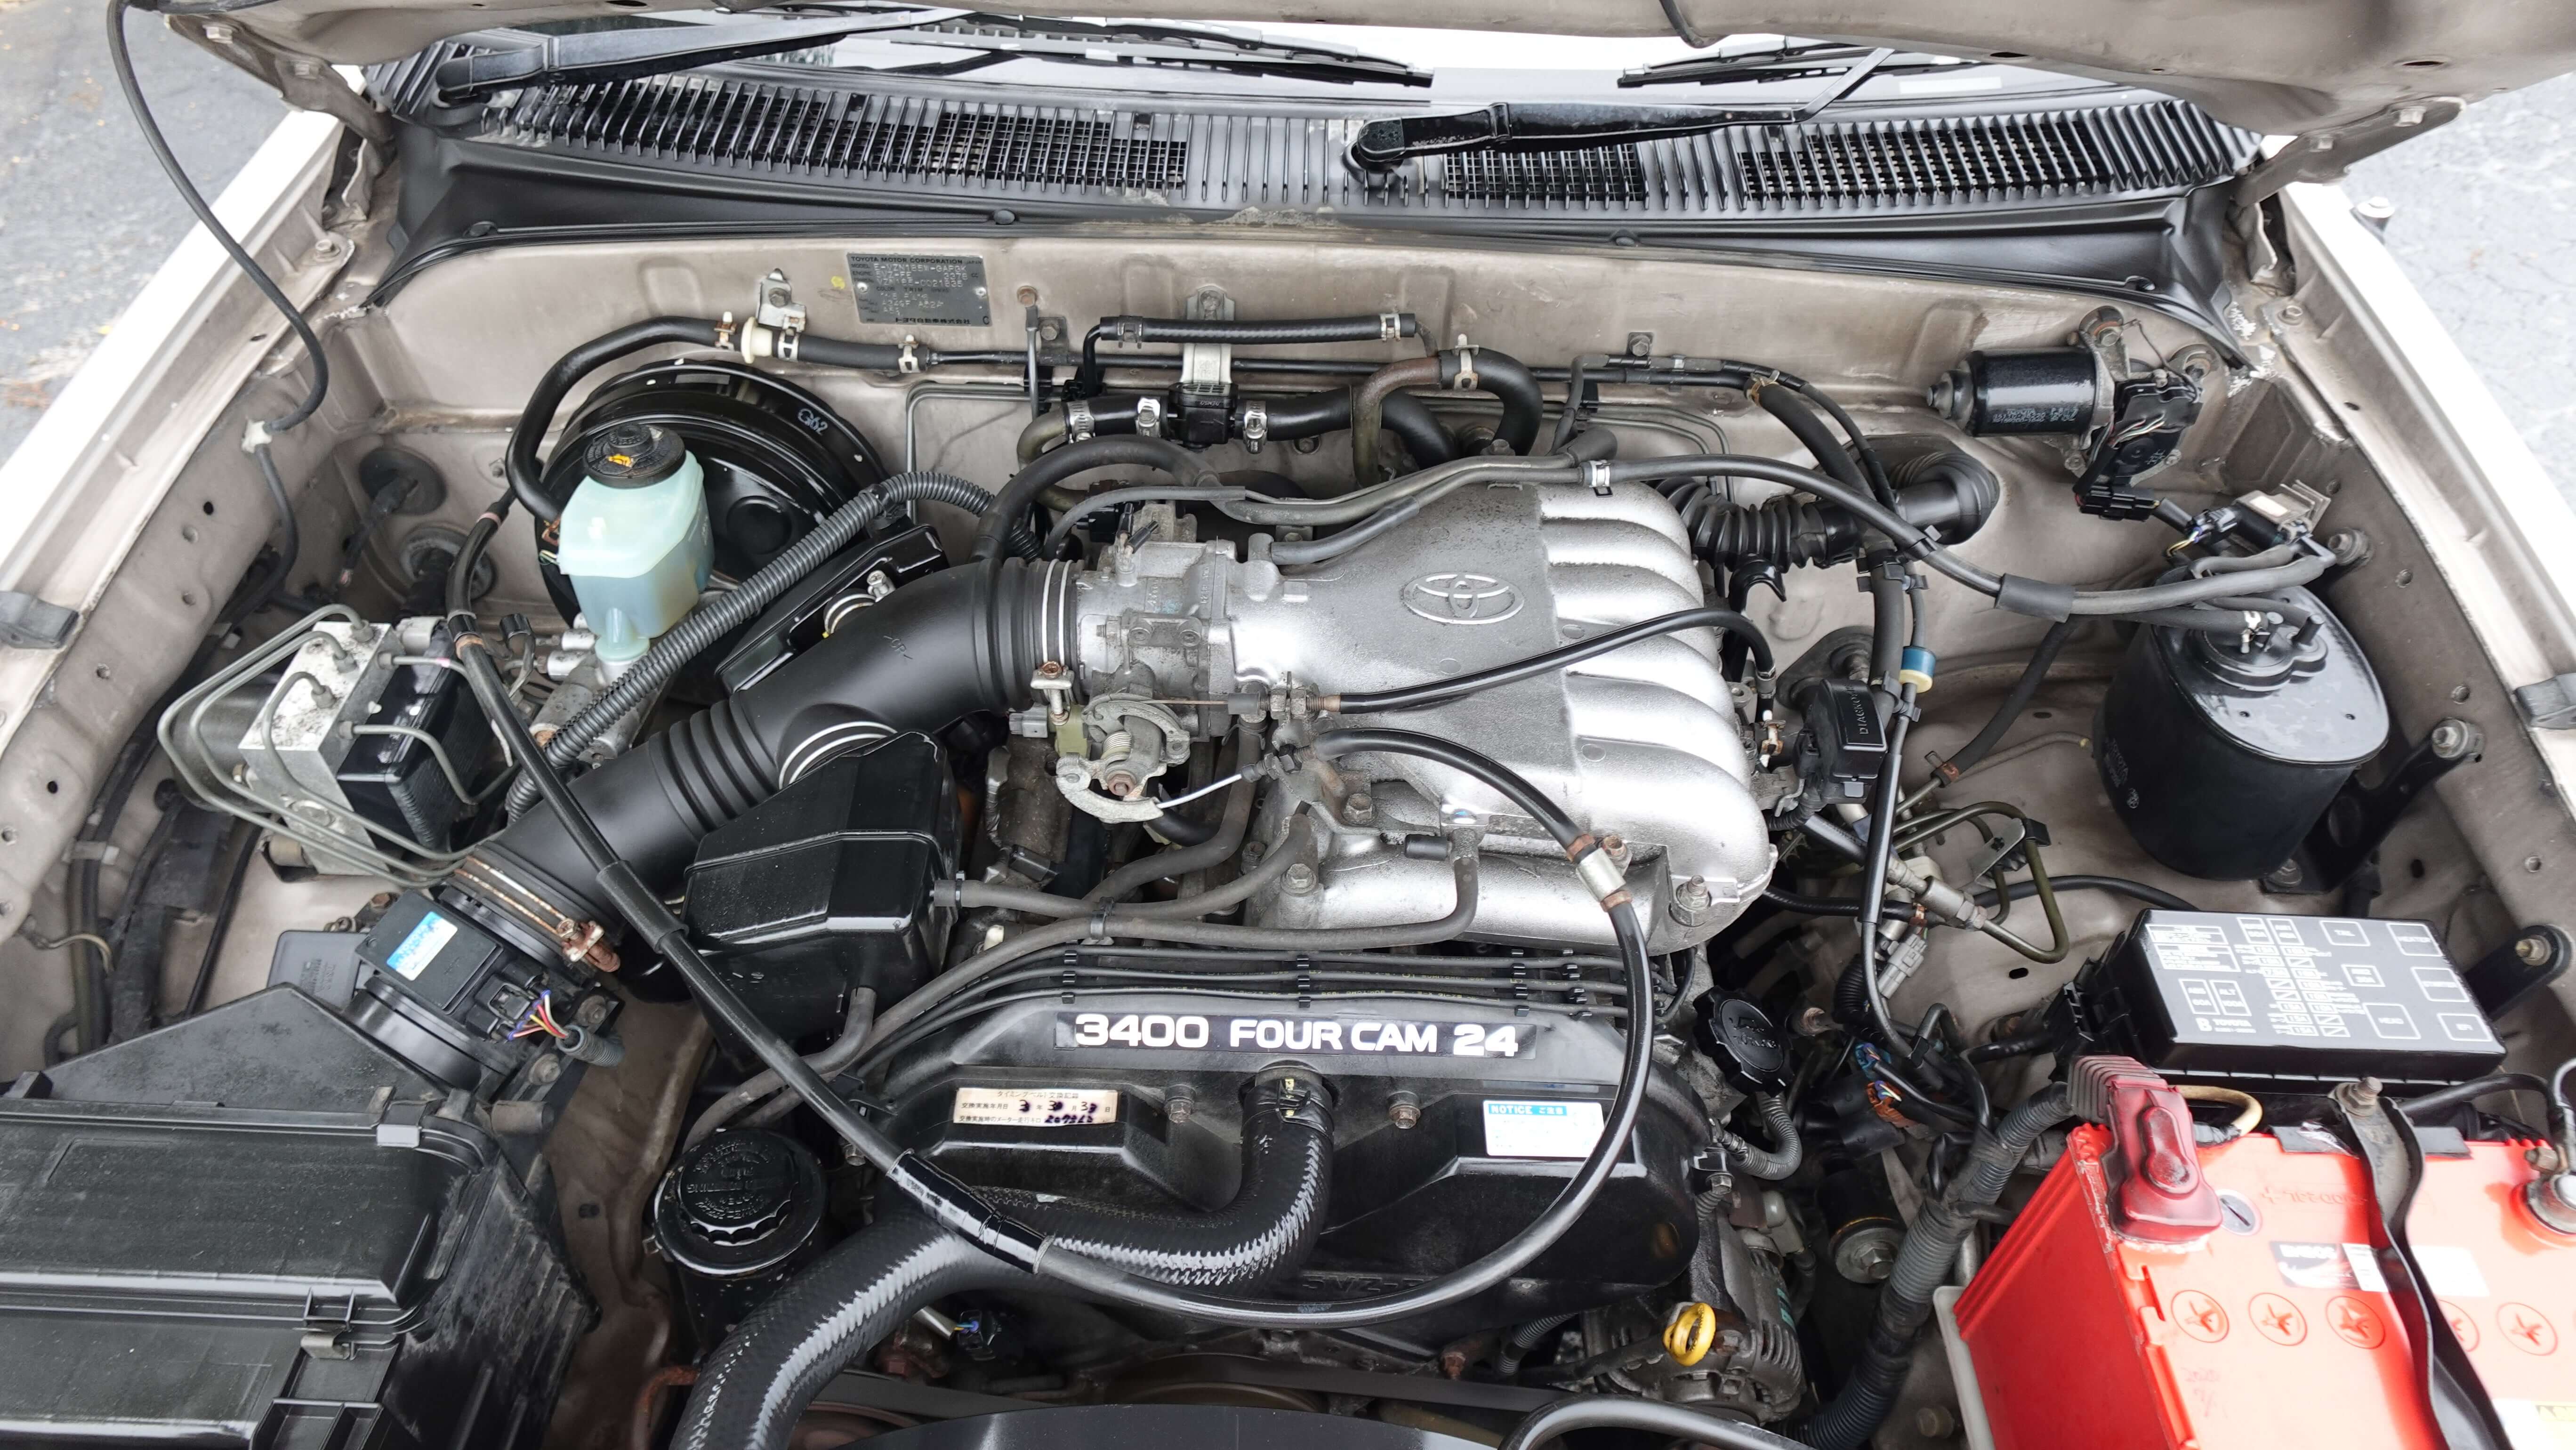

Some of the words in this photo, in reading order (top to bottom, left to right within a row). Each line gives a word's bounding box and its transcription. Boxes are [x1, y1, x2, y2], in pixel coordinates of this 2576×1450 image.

[2195, 1017, 2213, 1031] B
[2212, 1018, 2253, 1027] TOYOTA
[1075, 1014, 1209, 1048] 3400
[1230, 1019, 1342, 1050] FOUR
[1351, 1023, 1437, 1053] CAM
[1453, 1024, 1519, 1057] 24
[1490, 1104, 1533, 1115] NOTICE
